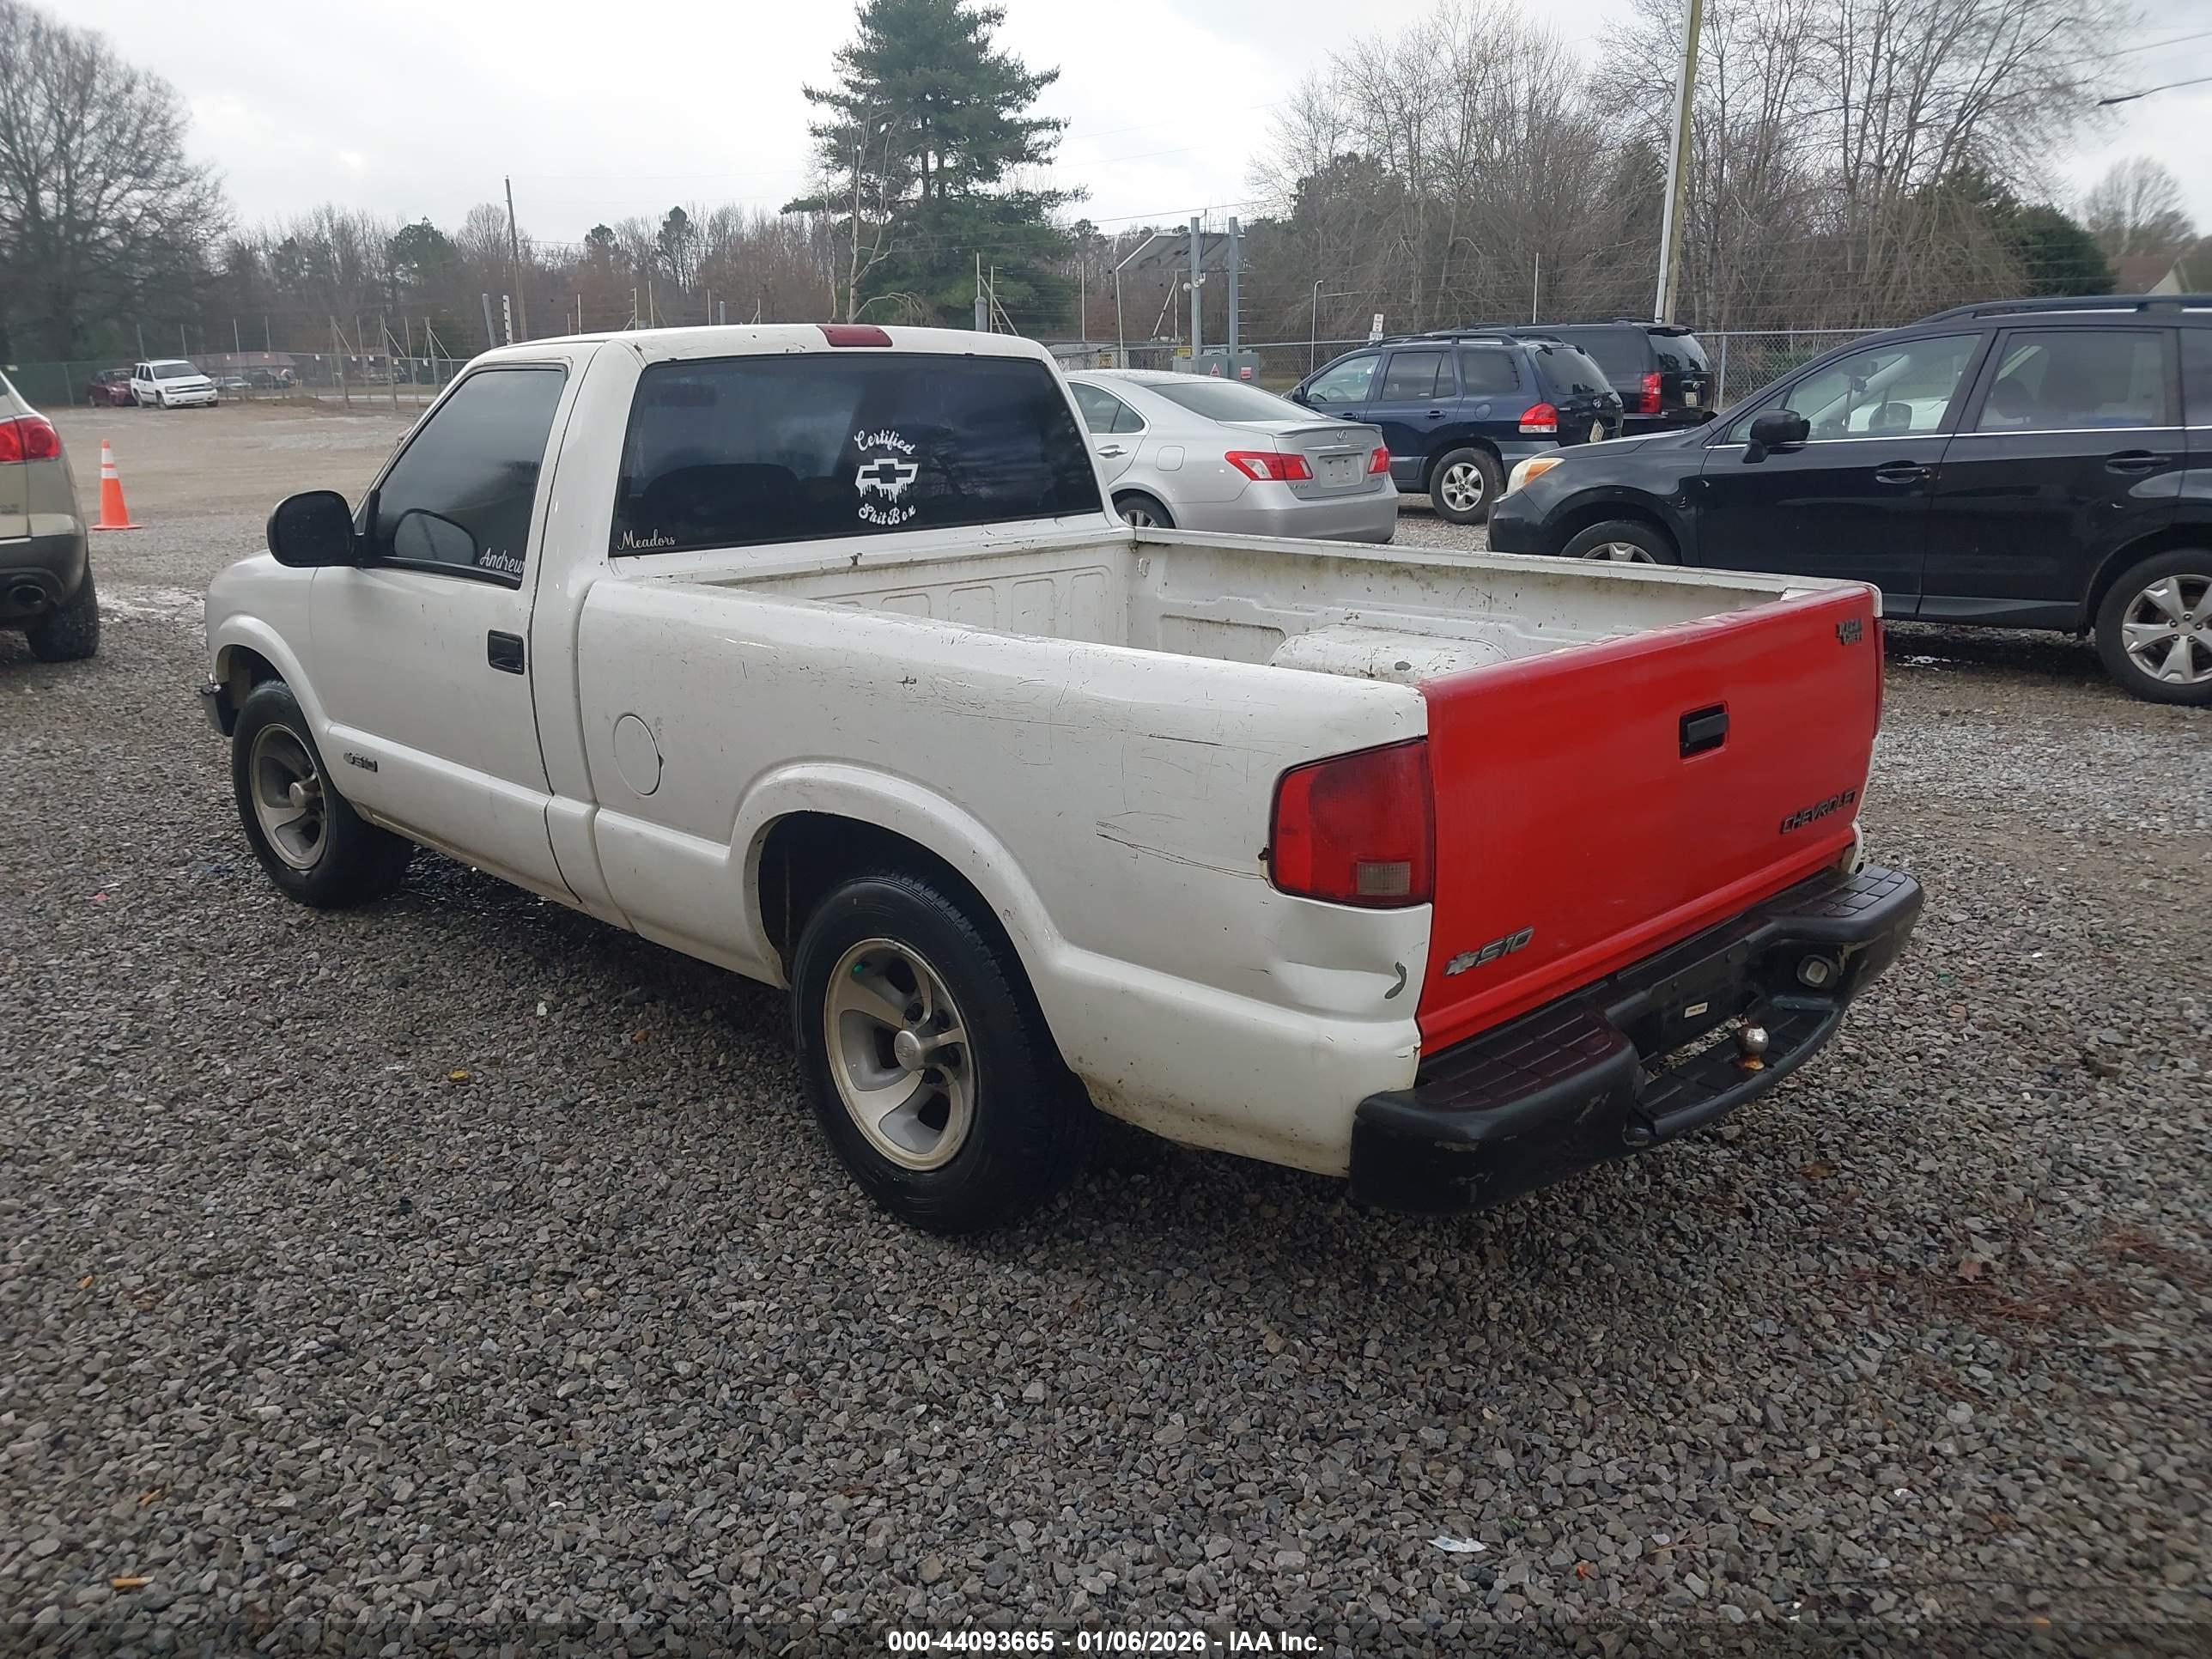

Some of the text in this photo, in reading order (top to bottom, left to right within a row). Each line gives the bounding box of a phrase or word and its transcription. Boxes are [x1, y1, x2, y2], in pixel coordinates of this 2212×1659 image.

[854, 429, 916, 455] Certified
[617, 529, 677, 550] Meadors
[479, 547, 526, 574] Andrew
[1779, 787, 1857, 834] CHEVROLET
[1475, 926, 1534, 967] S10
